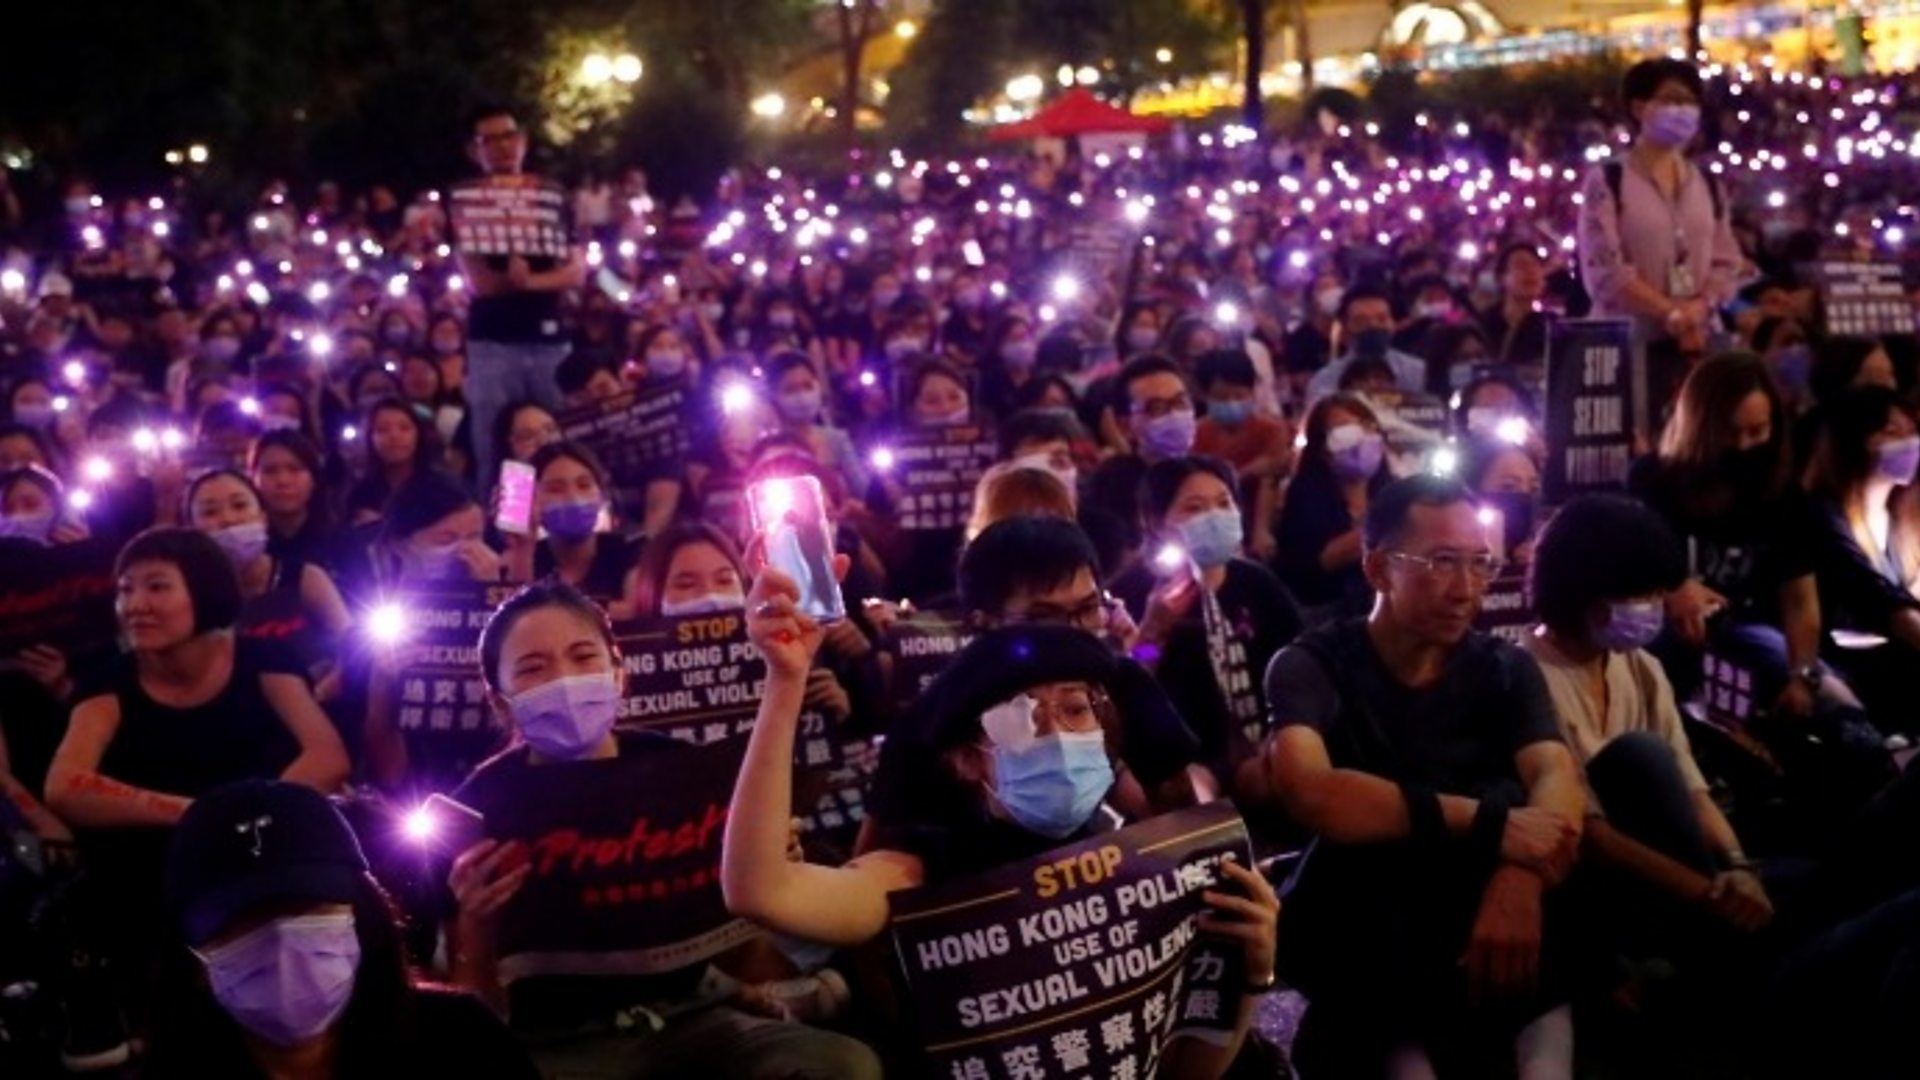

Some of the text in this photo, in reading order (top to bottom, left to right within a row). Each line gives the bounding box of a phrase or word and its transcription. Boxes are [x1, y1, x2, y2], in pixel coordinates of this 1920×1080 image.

[677, 617, 740, 643] STOP
[663, 644, 724, 671] KONG
[683, 665, 741, 688] USE OF
[617, 681, 766, 717] SEXUAL VIOLE
[1032, 844, 1124, 899] STOP
[916, 925, 1010, 972] HONG
[1017, 895, 1108, 947] KONG
[1051, 919, 1139, 966] USE OF
[956, 913, 1199, 1029] SEXUAL VIOLENC
